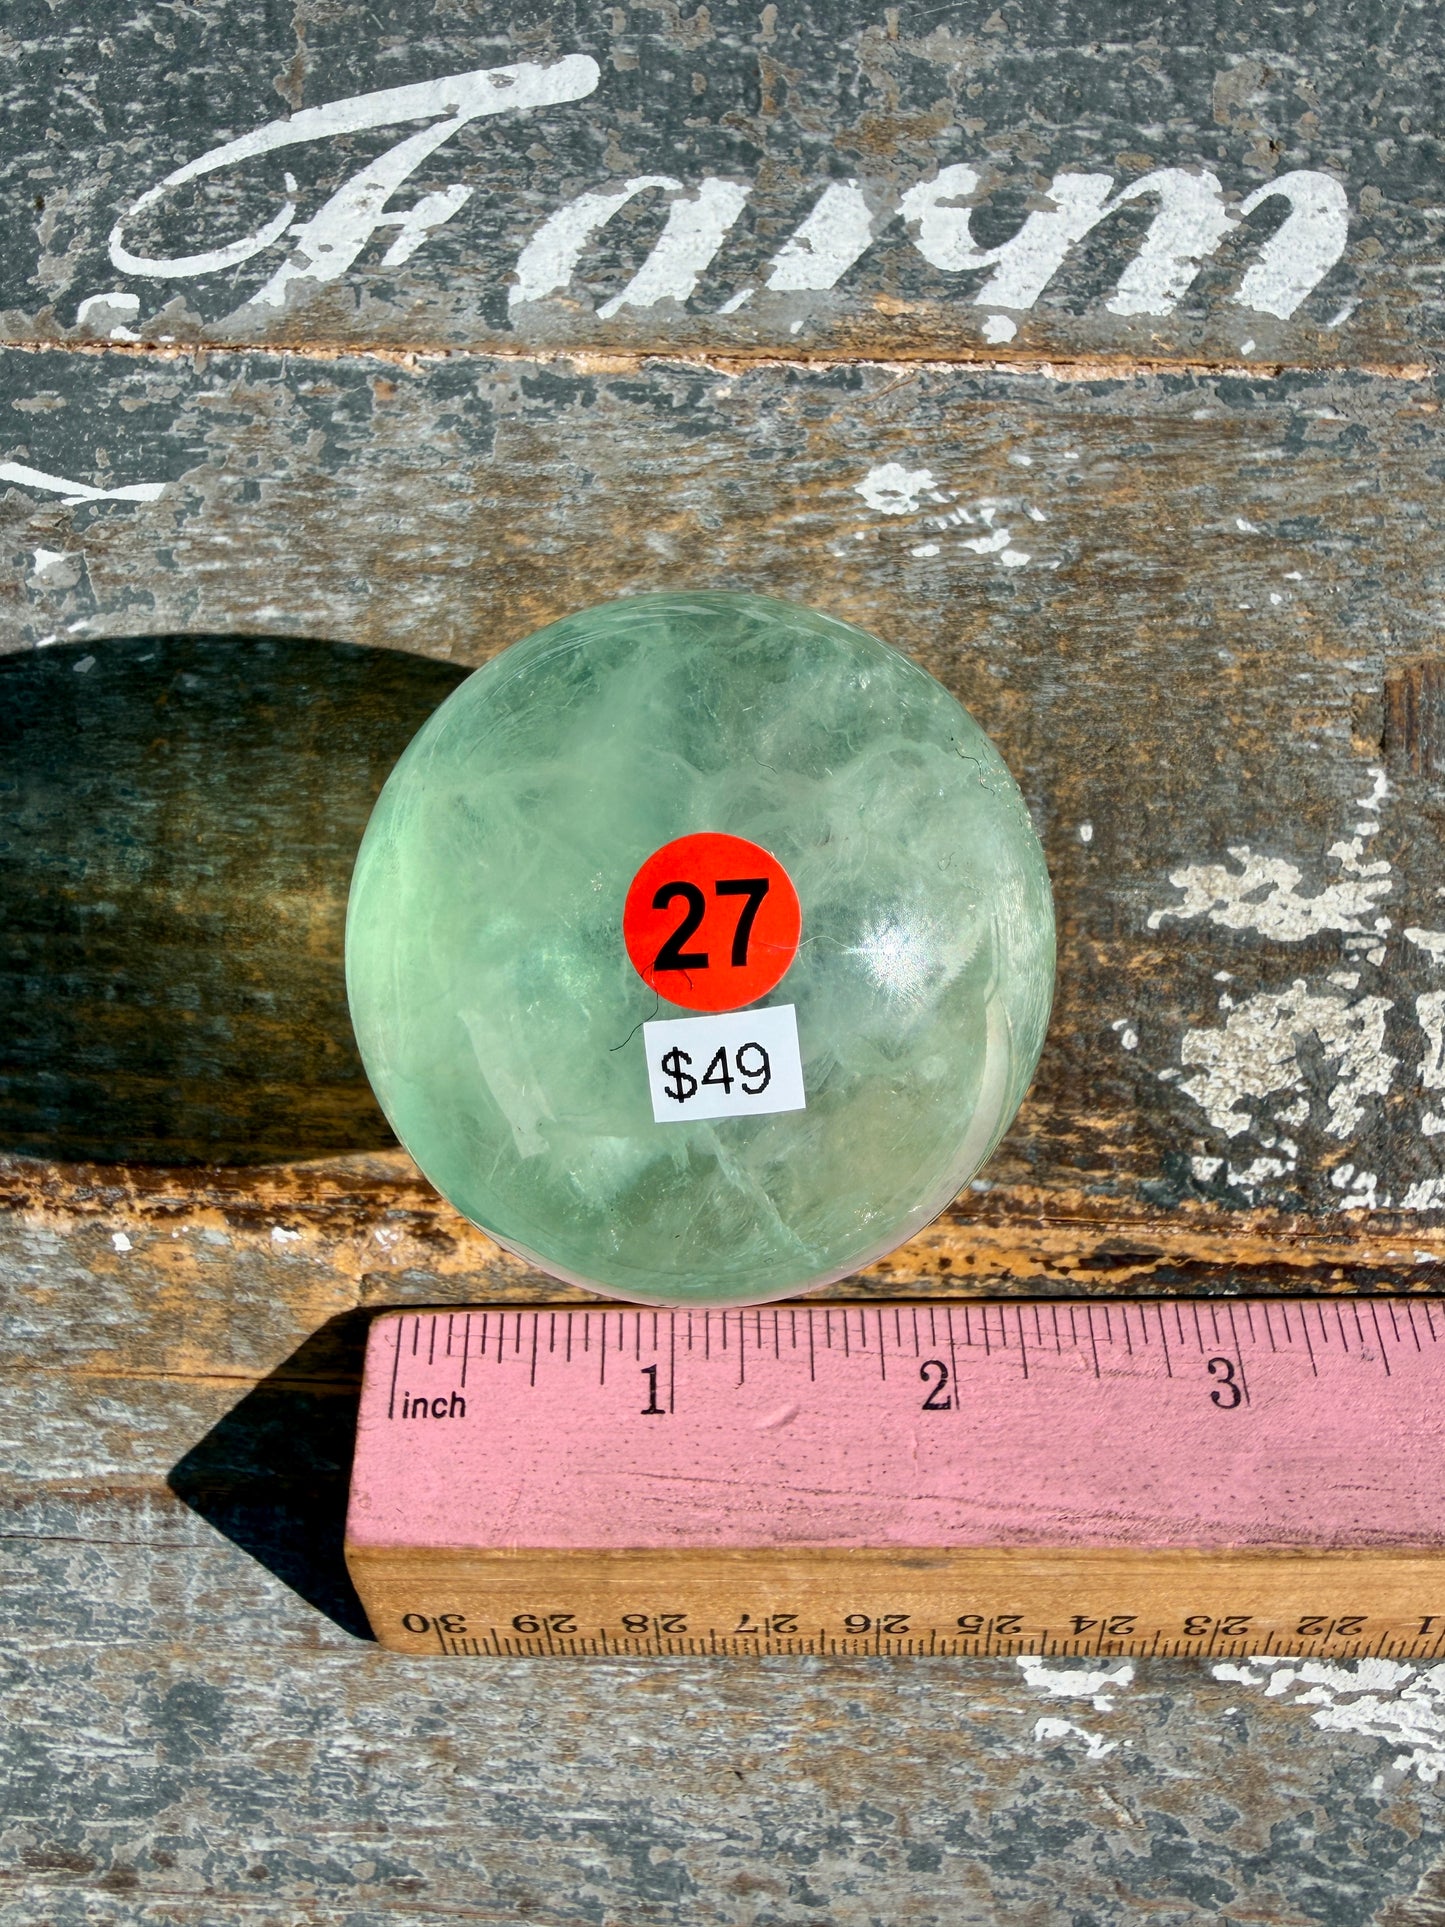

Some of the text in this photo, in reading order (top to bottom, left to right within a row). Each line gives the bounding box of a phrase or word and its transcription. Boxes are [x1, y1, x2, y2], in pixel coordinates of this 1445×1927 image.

[651, 878, 770, 971] 27
[660, 1041, 771, 1103] $49
[640, 1364, 666, 1415] 1
[919, 1360, 952, 1411] 2
[1207, 1357, 1242, 1410] 3
[402, 1391, 467, 1420] inch
[402, 1613, 468, 1634] 30
[511, 1614, 579, 1634] 29
[621, 1614, 688, 1634] 28
[733, 1614, 799, 1634] 27
[844, 1614, 911, 1634] 26
[956, 1614, 1025, 1635] 25
[1069, 1615, 1139, 1635] 24
[1183, 1615, 1254, 1635] 23
[1296, 1615, 1369, 1636] 22
